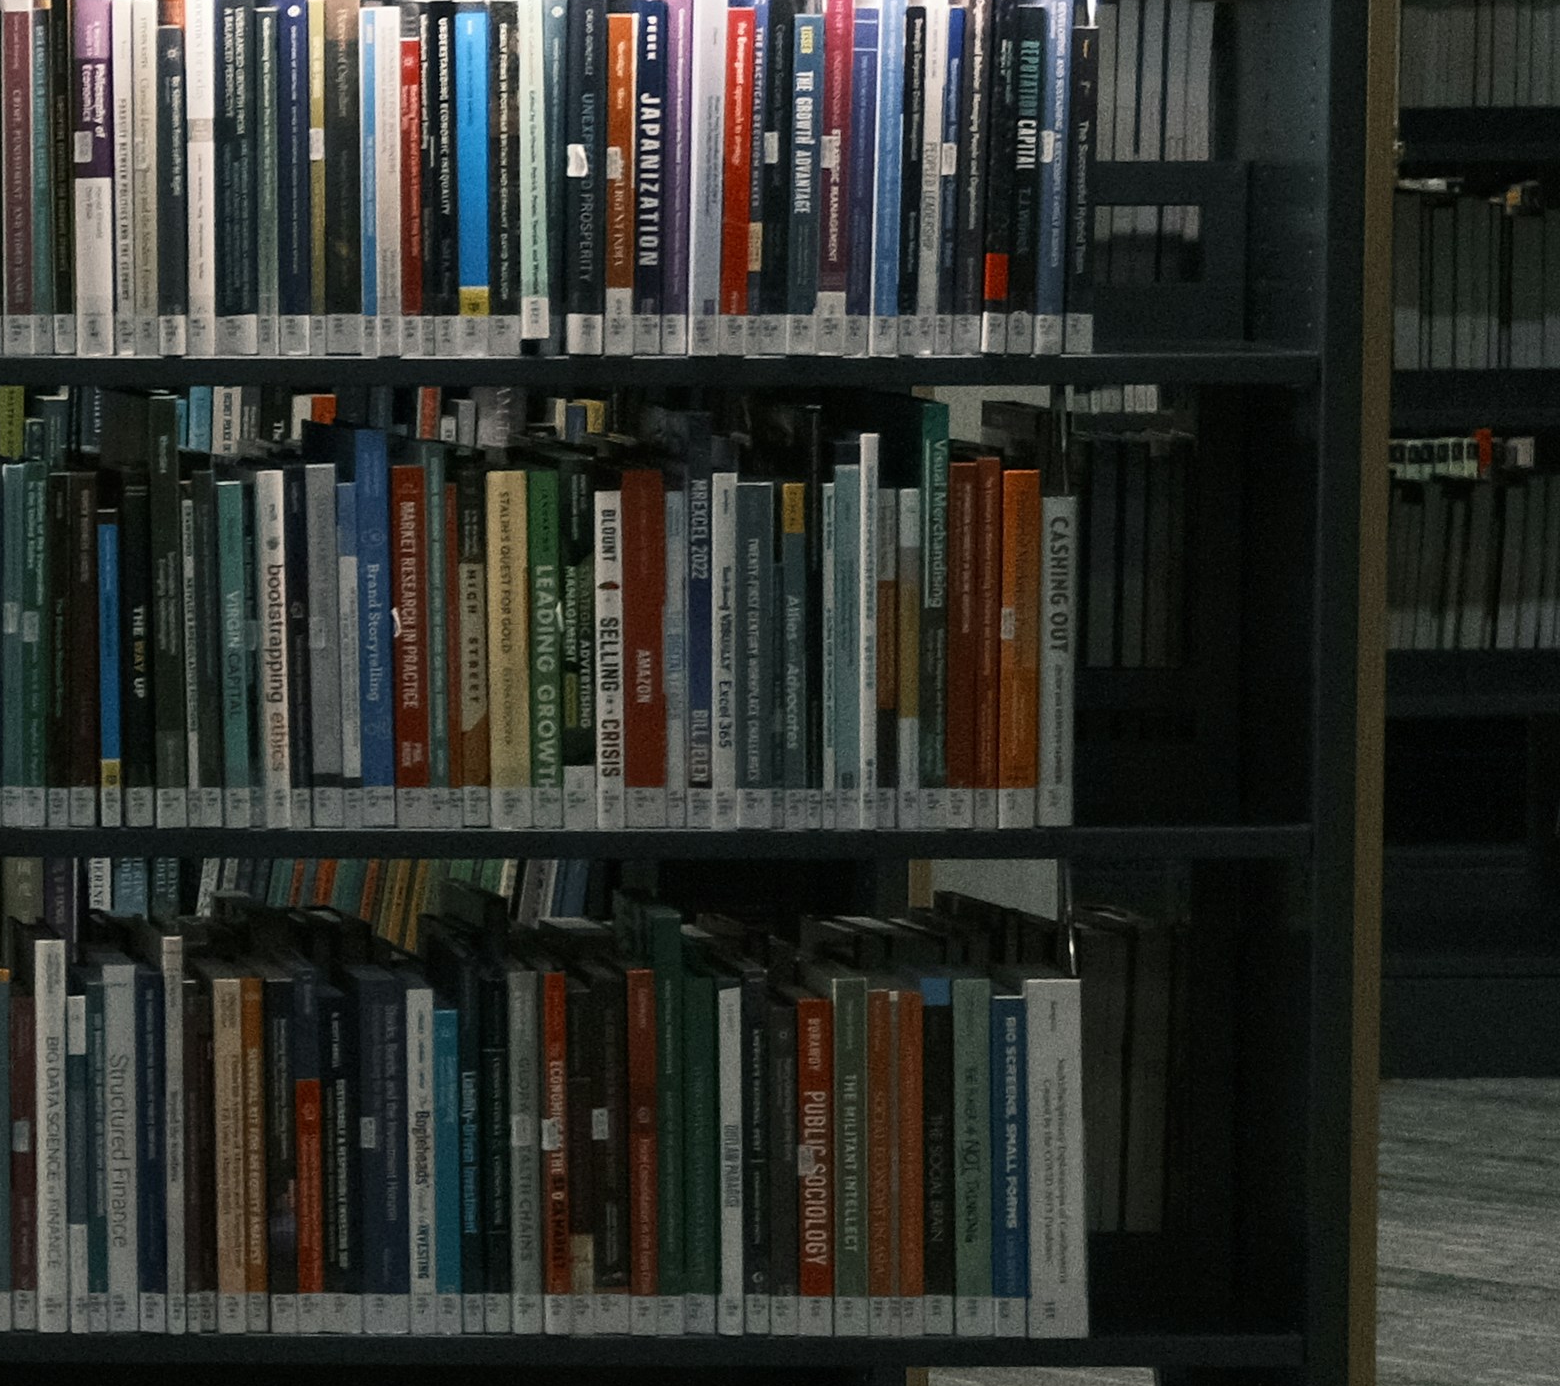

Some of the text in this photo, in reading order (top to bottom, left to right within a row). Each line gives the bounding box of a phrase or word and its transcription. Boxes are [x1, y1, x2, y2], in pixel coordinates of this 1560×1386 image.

[793, 71, 813, 214] THE GROWTH ADVANTAGE
[1015, 40, 1039, 170] REPUTATION CAPITAL
[639, 92, 660, 266] JAPANIZATION
[363, 563, 383, 701] Brand Storytelling
[690, 544, 708, 580] 2022
[1049, 516, 1069, 654] CASHING OUT
[265, 563, 287, 772] bootstrapping ethics
[536, 564, 557, 790] LEADING GROWTH
[600, 509, 619, 778] BLOUNT SELLING CRISIS
[636, 649, 651, 703] AMAZON
[691, 709, 708, 737] BILL
[691, 741, 708, 782] JELEN
[109, 1053, 130, 1248] Structured Finance
[803, 1090, 827, 1266] PUBLIC SOCIOLOGY
